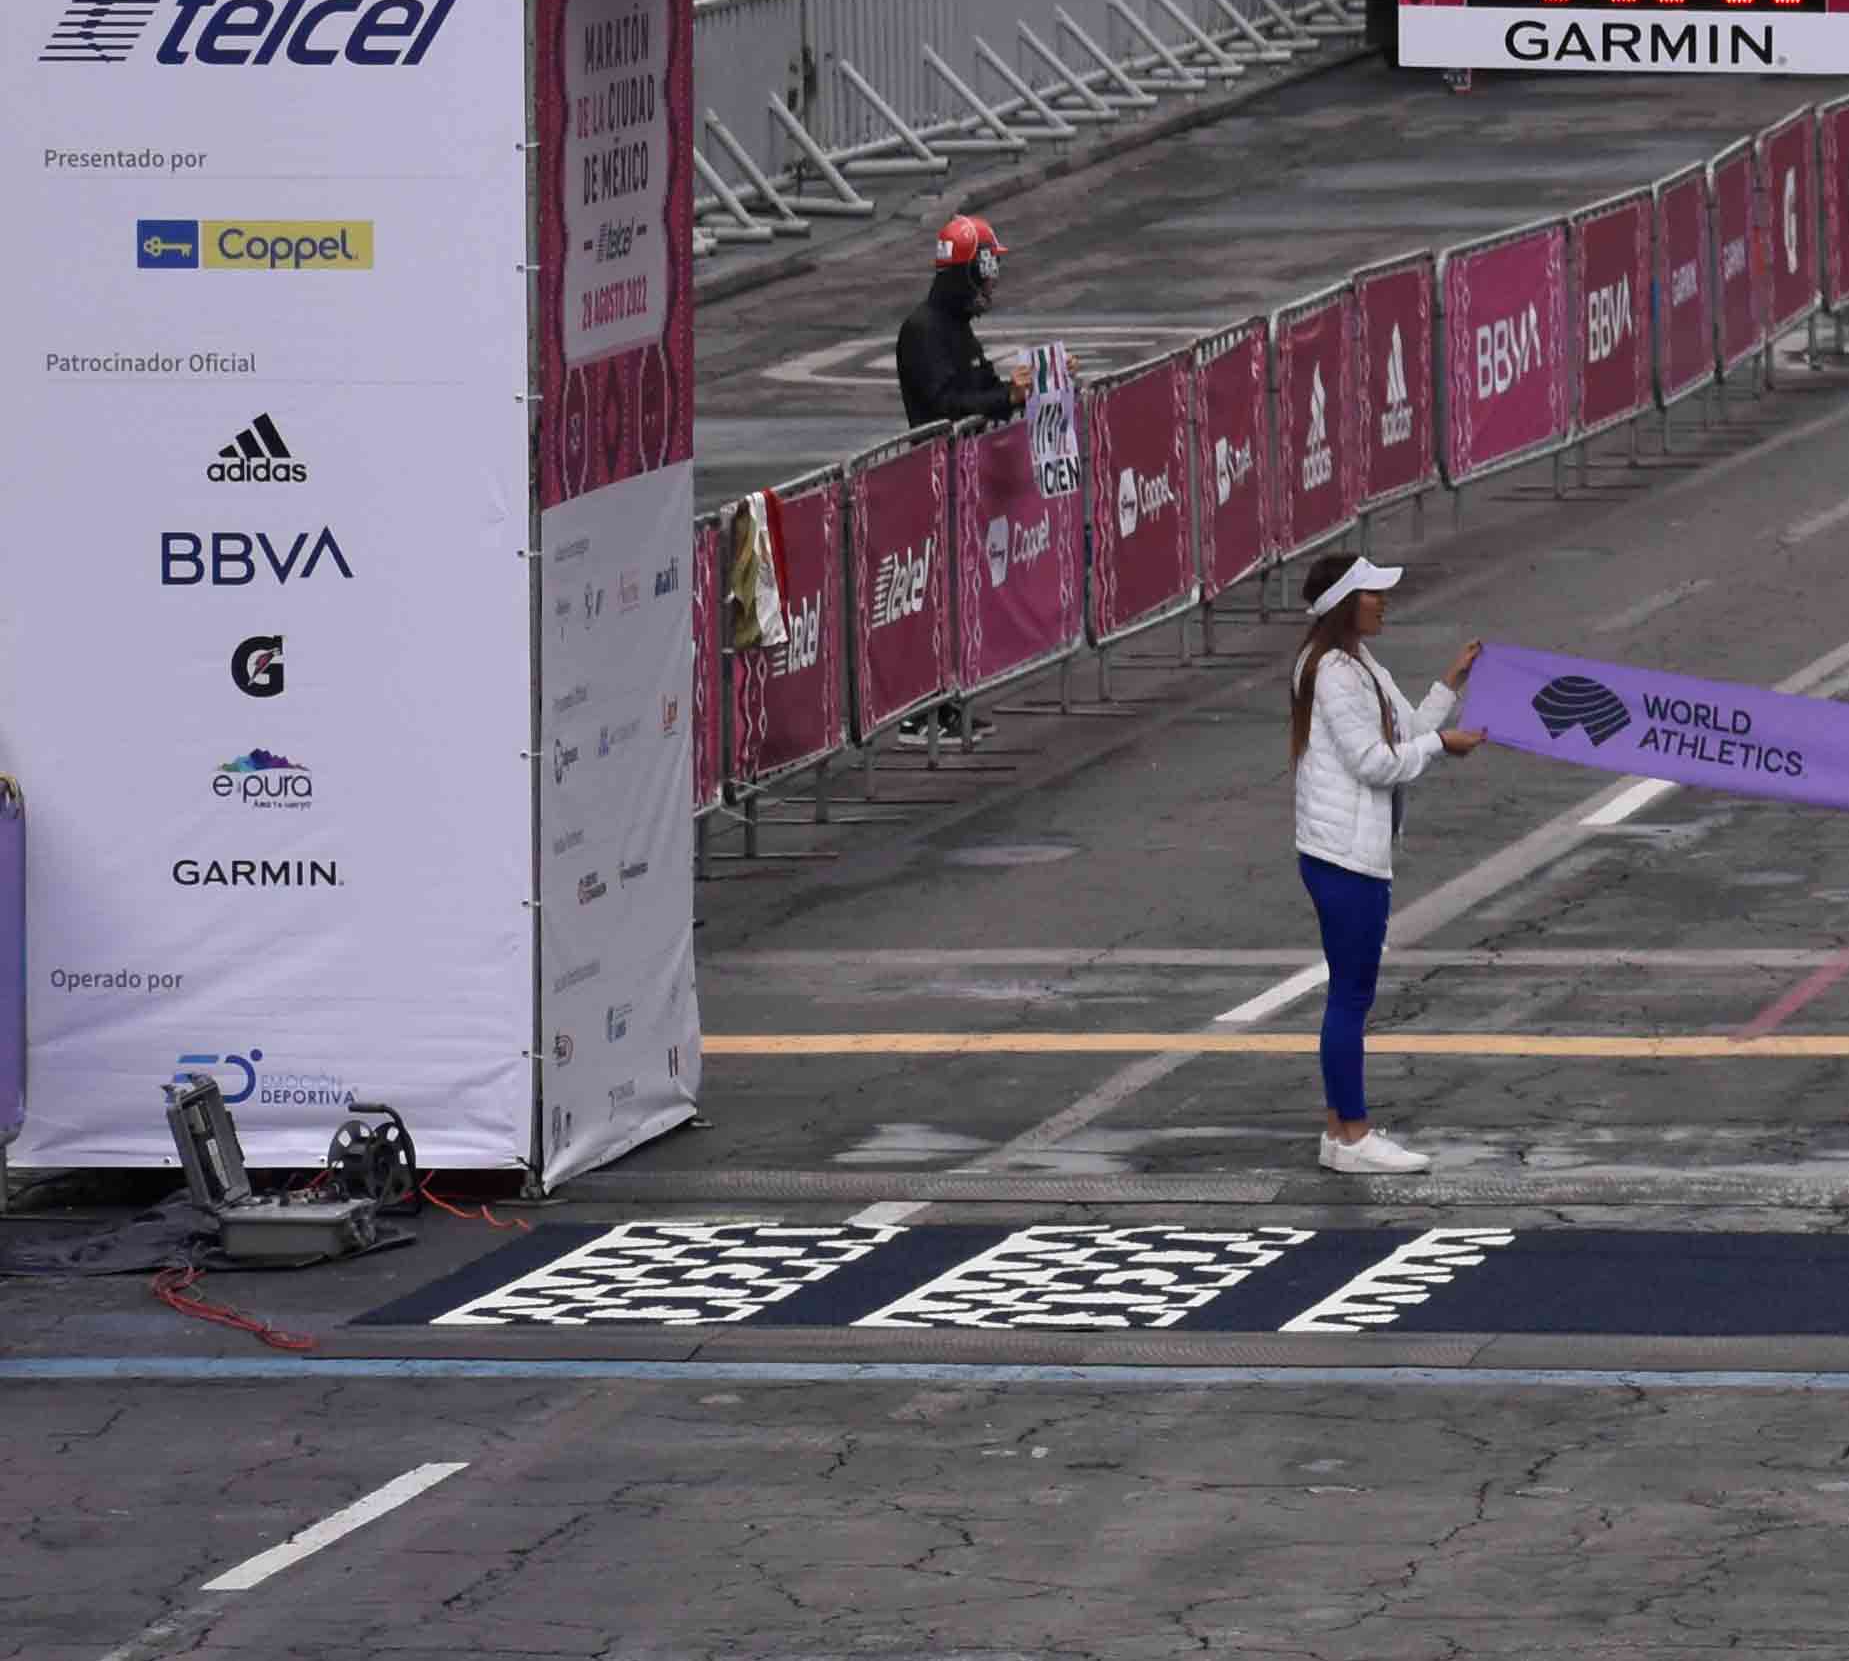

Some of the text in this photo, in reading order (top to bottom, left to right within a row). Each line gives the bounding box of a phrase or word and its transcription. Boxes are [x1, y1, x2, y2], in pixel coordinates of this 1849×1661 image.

[1504, 20, 1775, 66] GARMIN
[607, 74, 655, 132] CIUDAD
[44, 149, 207, 172] Presentado por
[583, 155, 598, 205] DE
[218, 228, 353, 269] Coppel
[1588, 271, 1632, 363] BBVA
[46, 353, 257, 373] Patrocinador Oficial
[1476, 301, 1541, 400] BBVA
[206, 456, 307, 482] adidas
[161, 526, 354, 585] BBVA
[1641, 692, 1752, 735] WORLD
[1638, 727, 1804, 777] ATHLETICS
[172, 860, 338, 887] GARMIN
[50, 969, 183, 993] Operado por
[260, 1090, 355, 1104] DEPORTIVA
